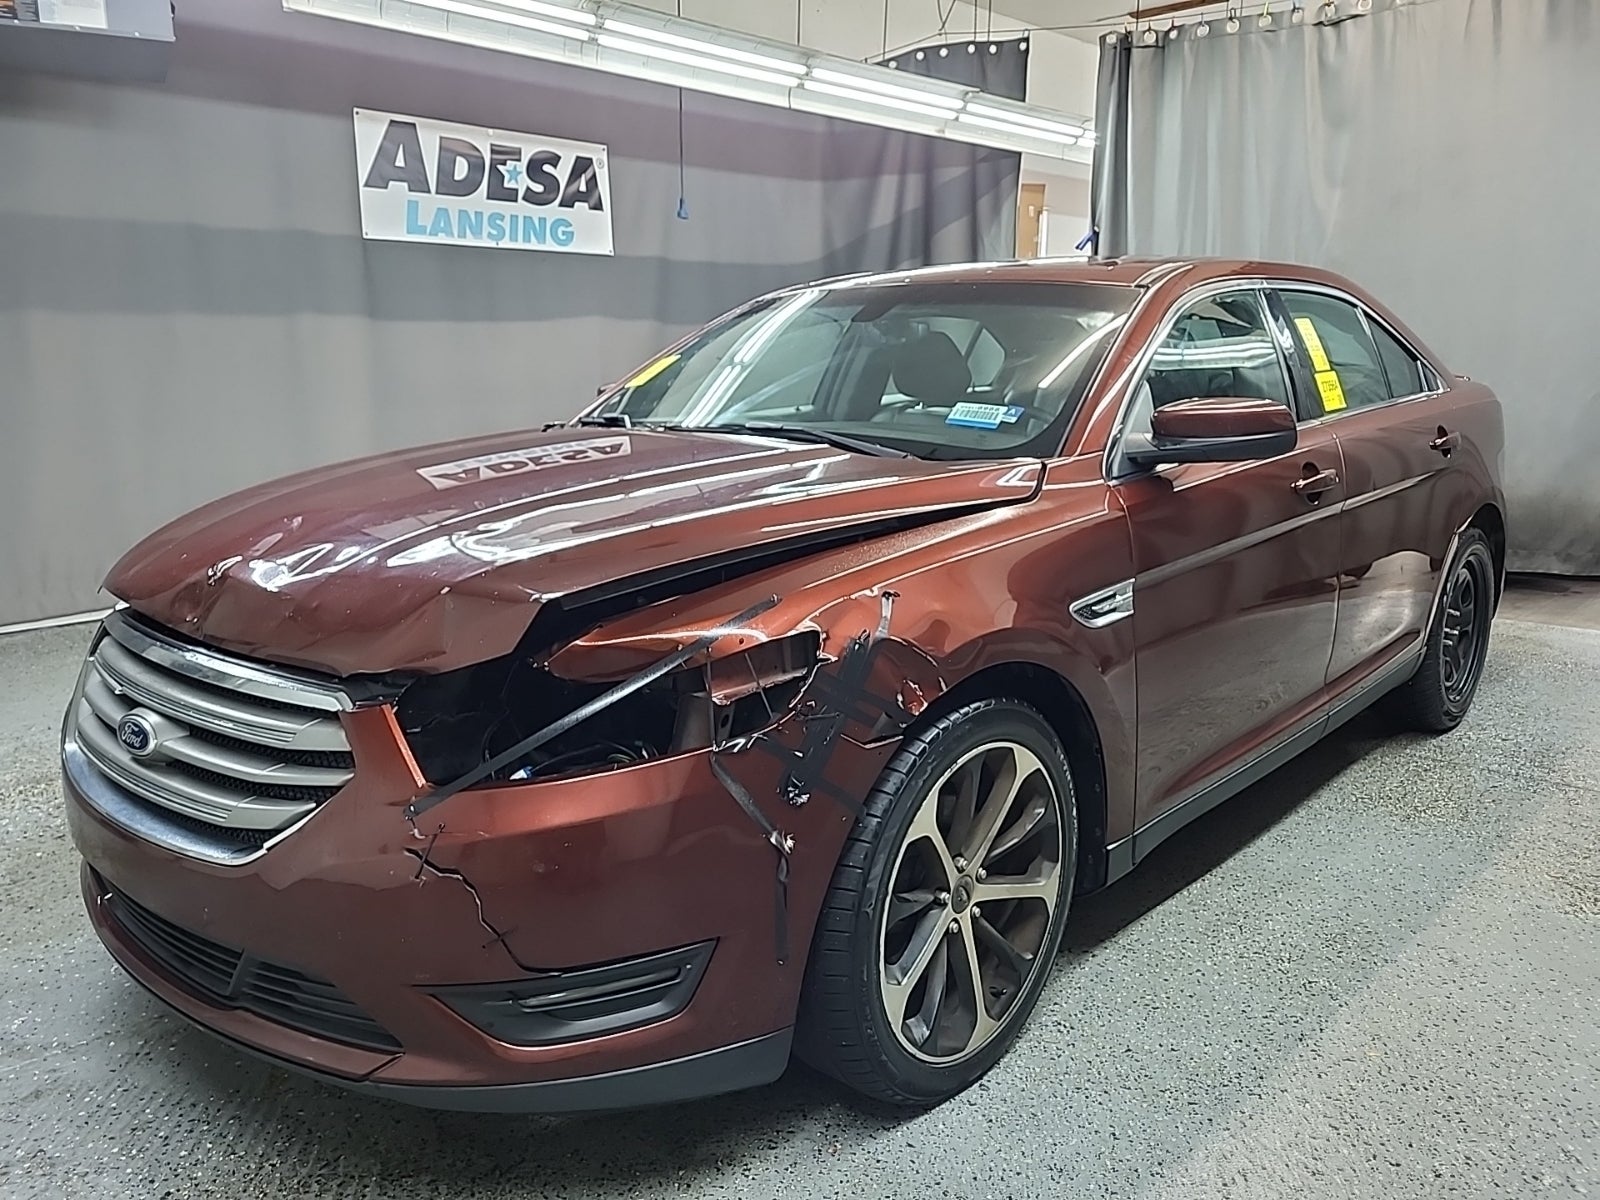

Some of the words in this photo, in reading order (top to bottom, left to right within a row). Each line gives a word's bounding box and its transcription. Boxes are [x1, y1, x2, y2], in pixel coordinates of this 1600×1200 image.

[363, 119, 604, 212] ADESA
[406, 200, 575, 247] LANSING
[121, 722, 144, 748] Ford
